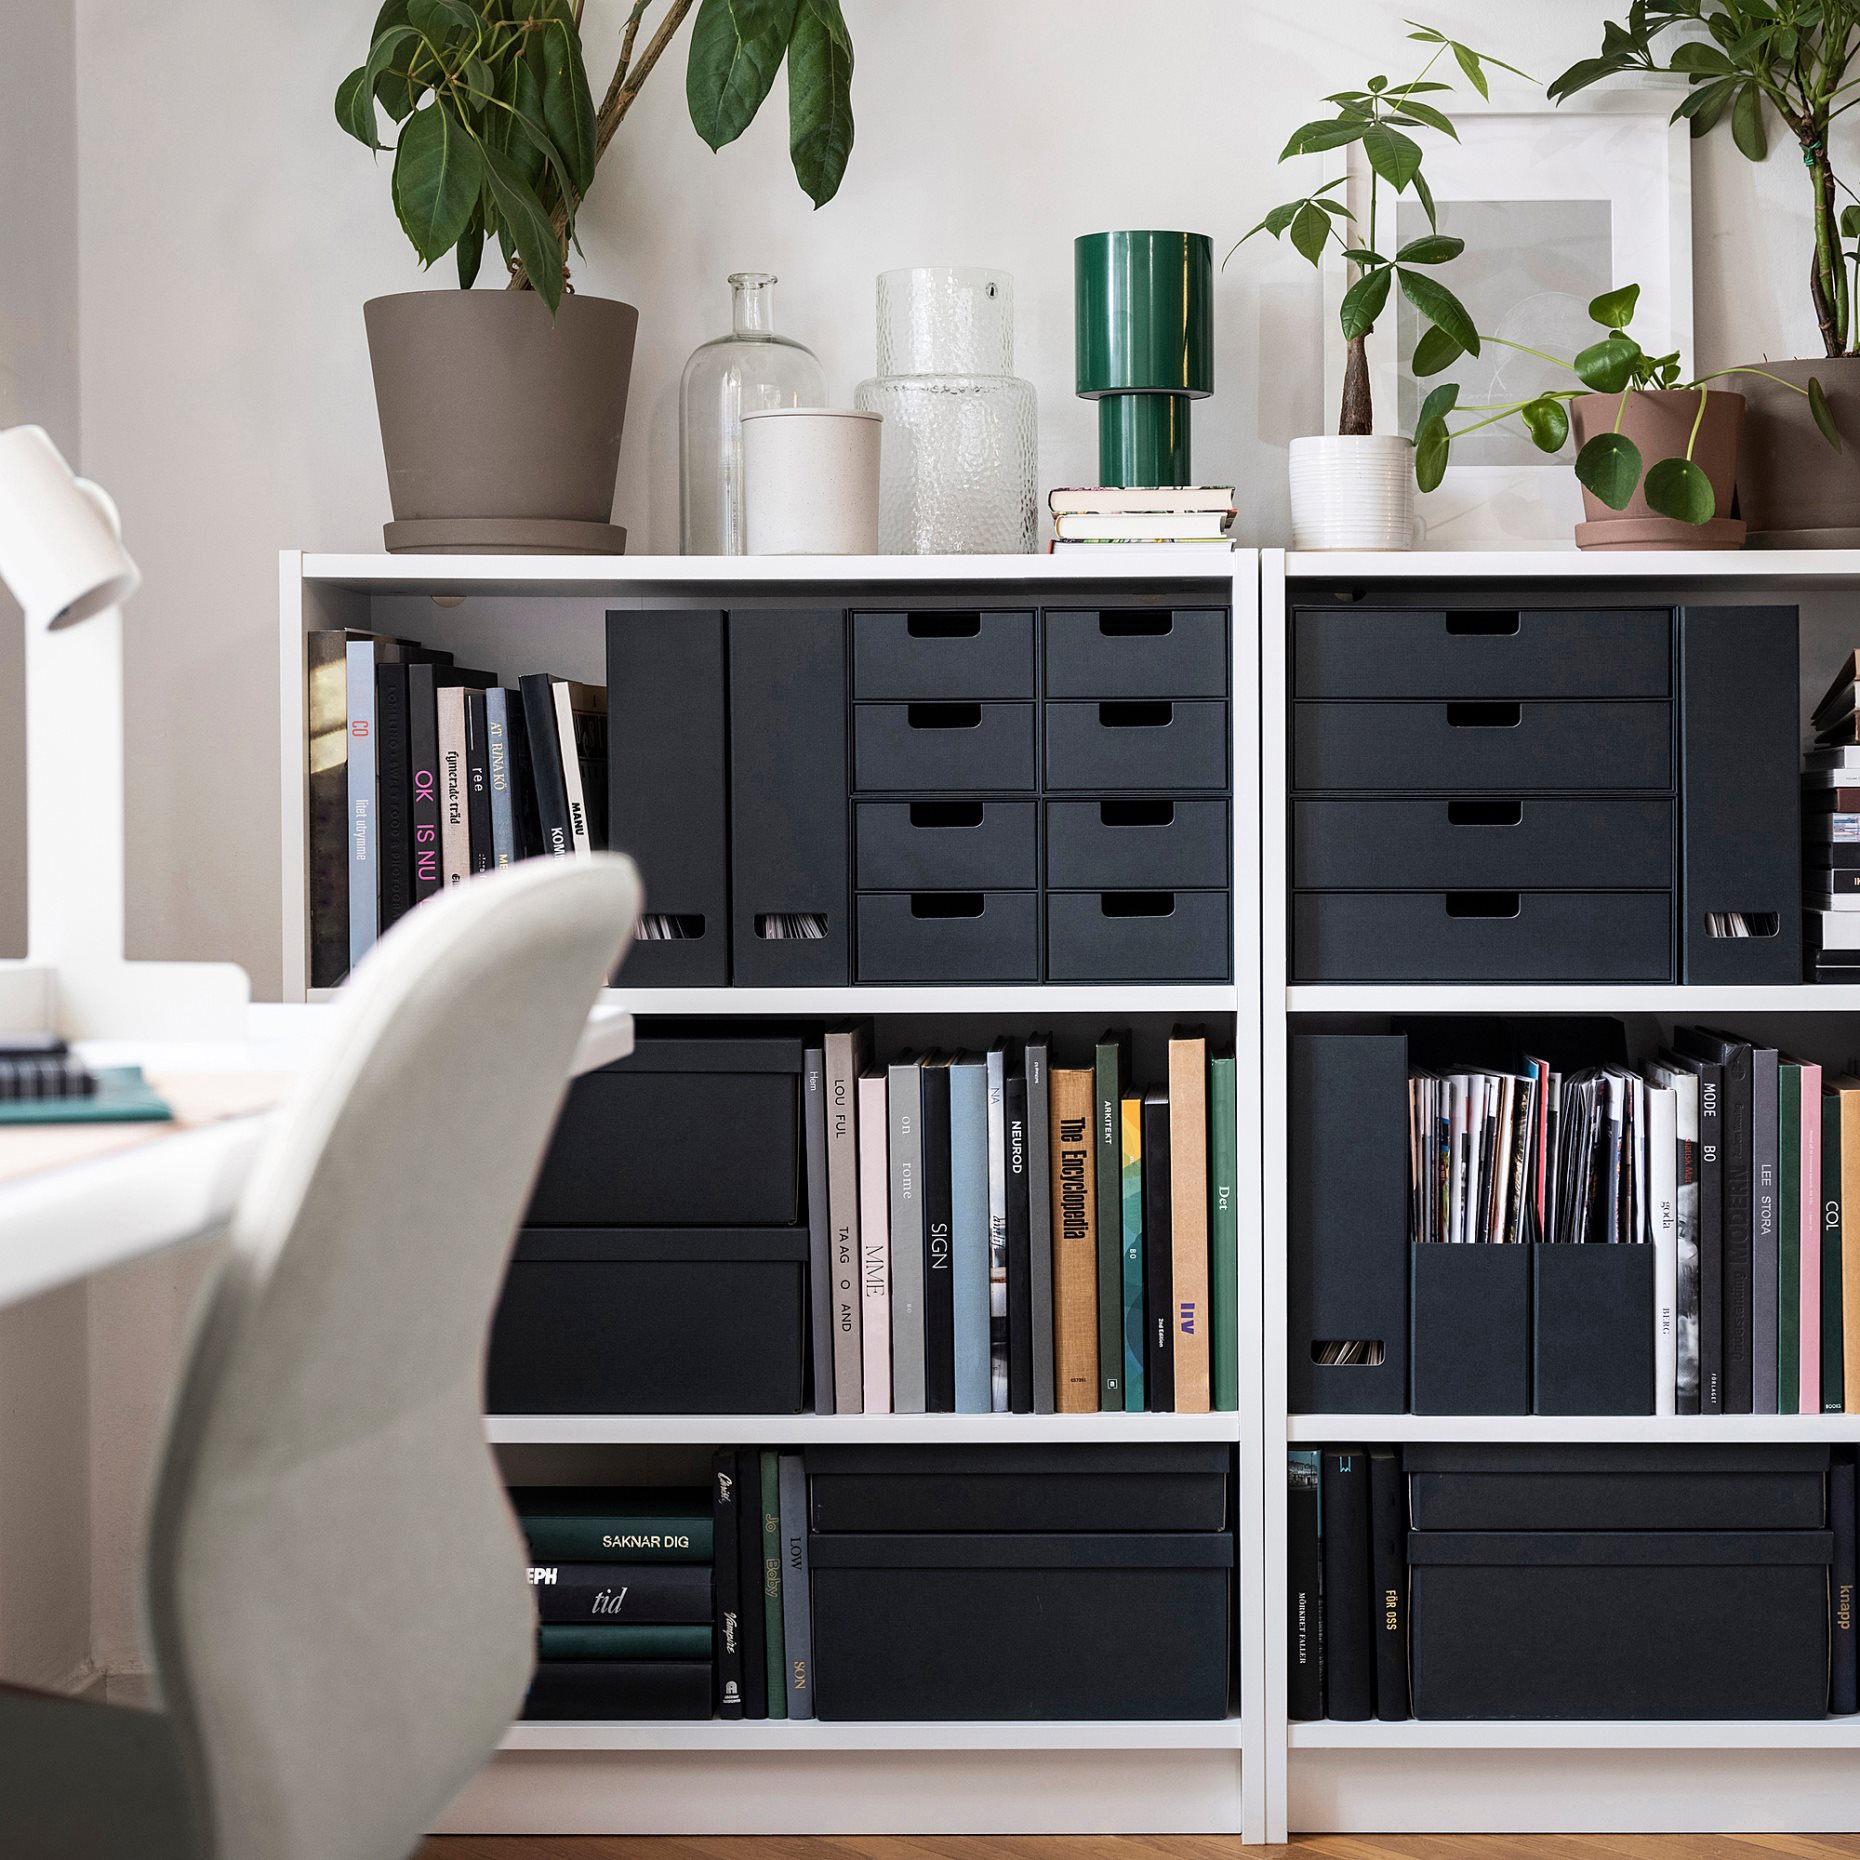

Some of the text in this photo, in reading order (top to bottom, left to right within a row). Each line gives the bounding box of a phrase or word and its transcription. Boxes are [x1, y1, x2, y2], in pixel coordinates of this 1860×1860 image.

[352, 720, 369, 737] CO
[414, 769, 434, 803] OK
[472, 767, 485, 792] ree
[449, 803, 461, 824] träd
[571, 801, 585, 836] MANU
[352, 799, 369, 861] litet utrymme
[416, 824, 436, 844] IS
[417, 850, 436, 881] NU
[809, 1071, 819, 1091] Hem
[834, 1080, 846, 1106] LOU
[990, 1087, 1001, 1105] NA
[836, 1114, 847, 1138] FUL
[1103, 1100, 1112, 1145] ARKITEKT
[1704, 1082, 1716, 1162] MODE BO
[901, 1115, 914, 1200] on rome
[1011, 1120, 1023, 1174] NEUROD
[1060, 1117, 1089, 1240] The Encyclopedia
[1218, 1185, 1230, 1210] Det
[1760, 1163, 1773, 1235] LEE STORA
[1660, 1200, 1674, 1229] goda
[1825, 1200, 1839, 1231] COL
[931, 1223, 948, 1269] SIGN
[841, 1279, 851, 1290] O
[865, 1245, 885, 1298] MME
[841, 1303, 852, 1332] AND
[1663, 1307, 1671, 1334] BERG
[764, 1512, 779, 1533] Jo
[602, 1535, 689, 1549] SAKNAR DIG
[591, 1586, 628, 1615] tid
[790, 1537, 806, 1689] LOW SON
[1385, 1590, 1398, 1630] FÖR OSS
[1837, 1584, 1852, 1630] knapp
[721, 1612, 737, 1654] Vampire
[1298, 1592, 1308, 1664] MÖRKRET FALLER
